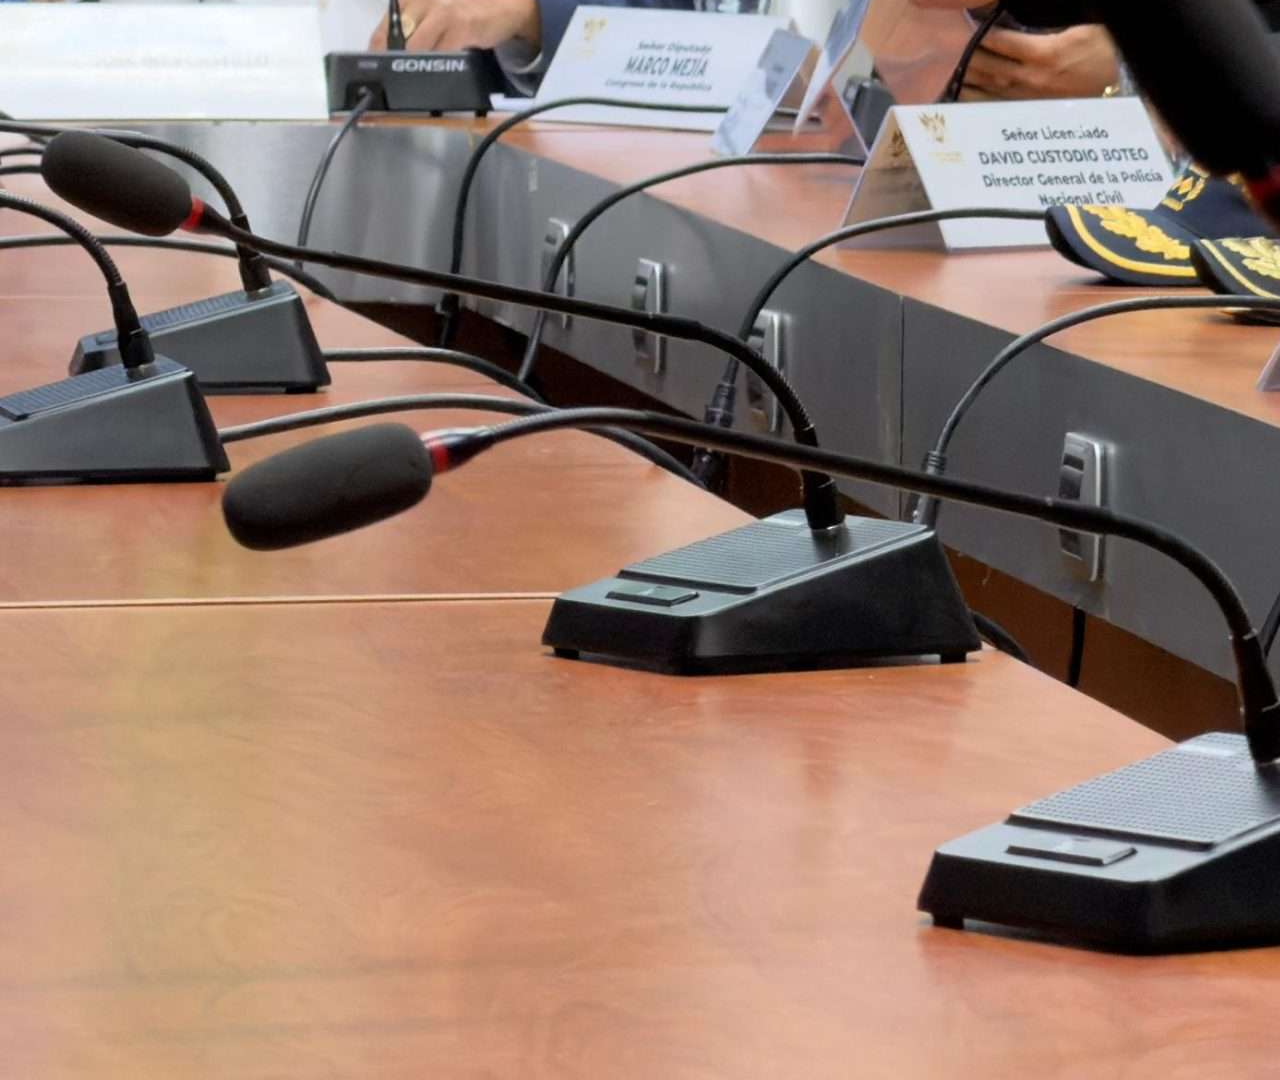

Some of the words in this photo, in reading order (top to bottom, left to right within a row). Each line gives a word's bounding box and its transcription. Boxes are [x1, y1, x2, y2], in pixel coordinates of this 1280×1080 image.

[391, 58, 466, 73] GONSIN
[625, 56, 670, 76] MARCO
[1001, 127, 1039, 142] Señor
[979, 150, 1024, 166] DAVID
[1027, 148, 1099, 165] CUSTODIO
[1102, 147, 1149, 163] BOTEO
[982, 173, 1034, 188] Director
[1037, 171, 1086, 186] General
[1089, 170, 1107, 185] de
[1108, 169, 1119, 184] la
[1038, 191, 1094, 206] Nacional
[1096, 190, 1124, 205] Civil
